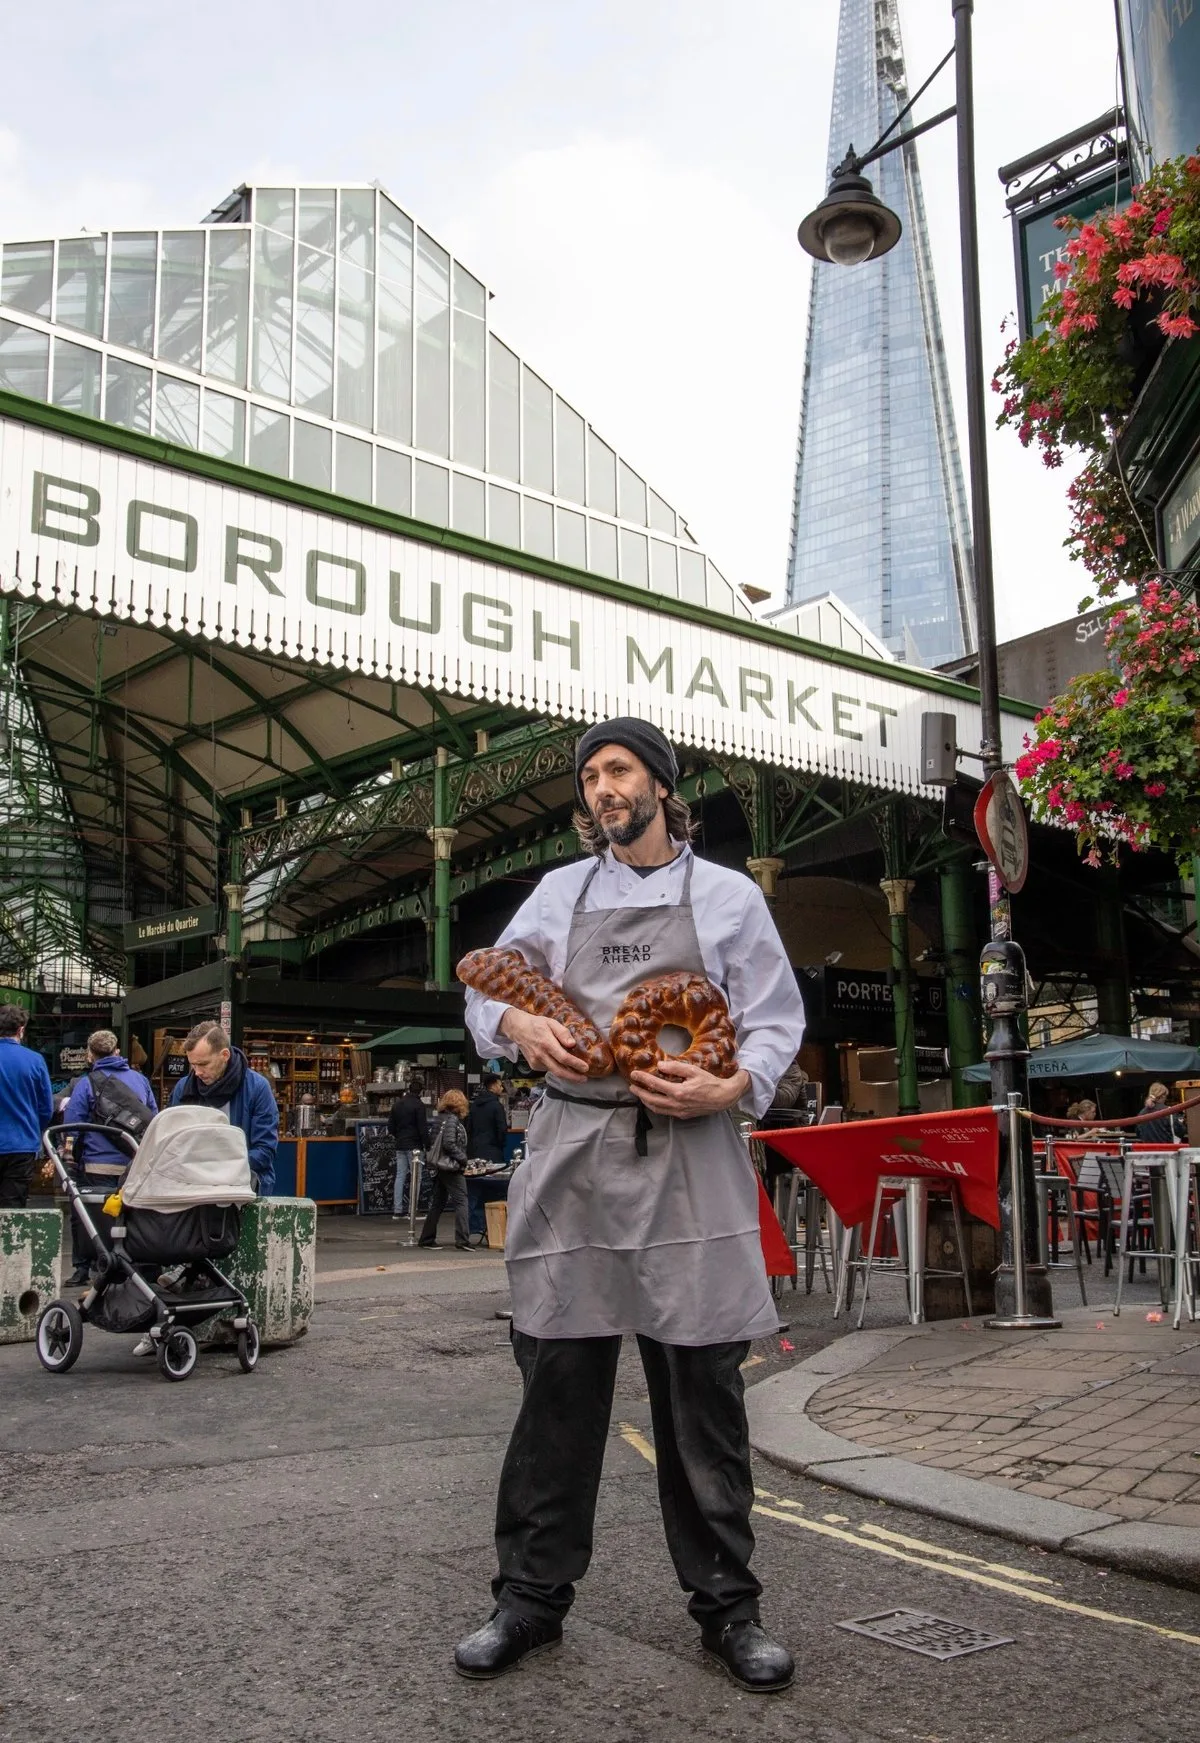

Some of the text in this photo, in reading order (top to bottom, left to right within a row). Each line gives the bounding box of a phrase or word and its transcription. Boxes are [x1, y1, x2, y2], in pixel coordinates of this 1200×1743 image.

[31, 470, 898, 748] BOROUGH MARKET
[138, 916, 199, 938] Le Marché du Quartier
[602, 944, 651, 955] BREAD
[602, 953, 651, 964] AHEAD
[837, 981, 893, 1002] PORTE
[1029, 1060, 1069, 1074] RTEÑA
